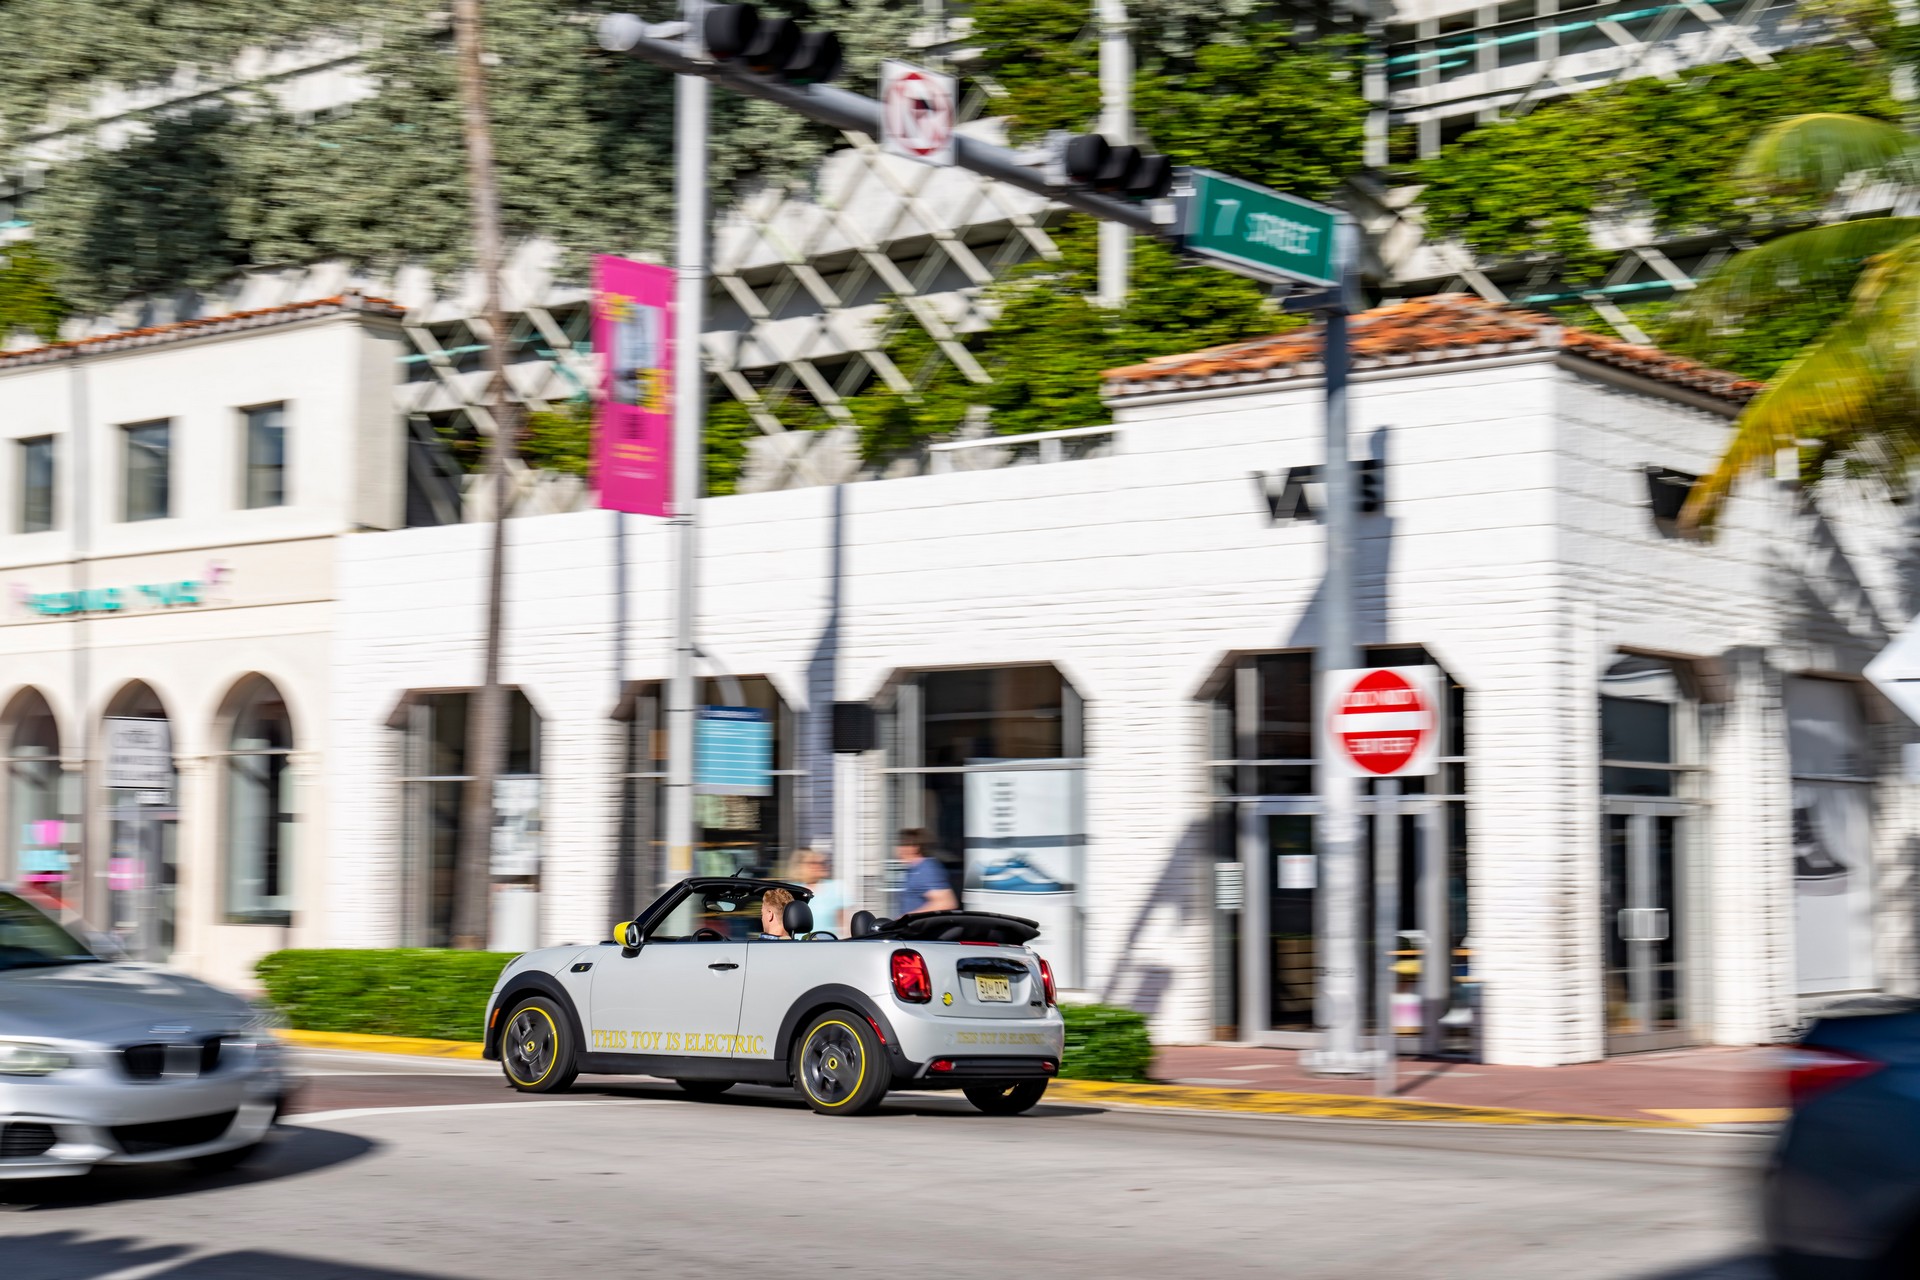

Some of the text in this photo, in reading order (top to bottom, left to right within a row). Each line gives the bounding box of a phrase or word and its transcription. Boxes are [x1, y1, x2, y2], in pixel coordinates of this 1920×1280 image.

[592, 1029, 767, 1055] THIS TOY IS ELECTRIC.
